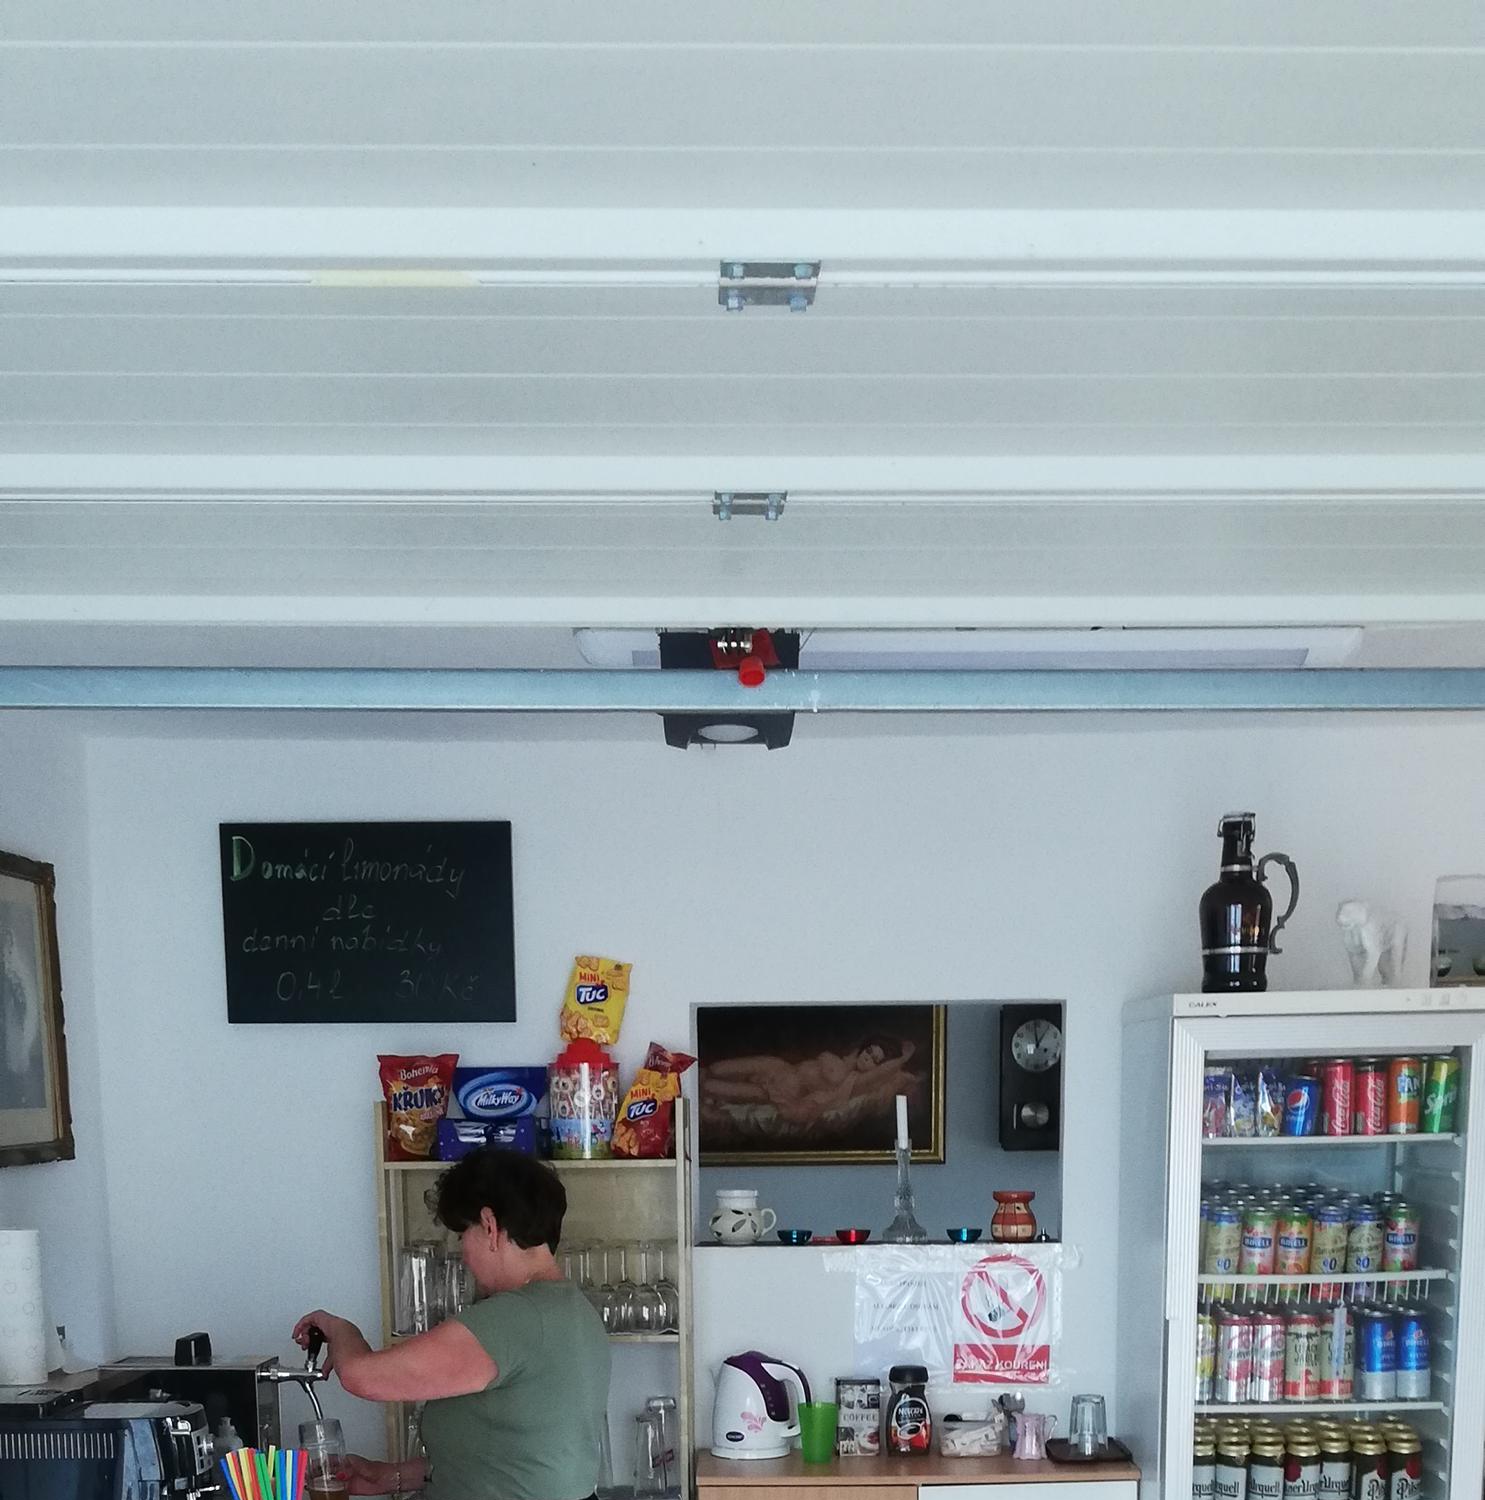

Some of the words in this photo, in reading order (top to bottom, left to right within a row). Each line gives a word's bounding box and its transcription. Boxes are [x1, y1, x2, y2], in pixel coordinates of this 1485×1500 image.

[230, 835, 335, 882] Domácí
[342, 838, 465, 899] limonády
[322, 894, 377, 921] dle
[579, 987, 605, 1002] TUC
[400, 1063, 440, 1081] Bohemia
[630, 1087, 653, 1099] MINI
[629, 1102, 655, 1118] TUC
[843, 1413, 876, 1421] COFFEE
